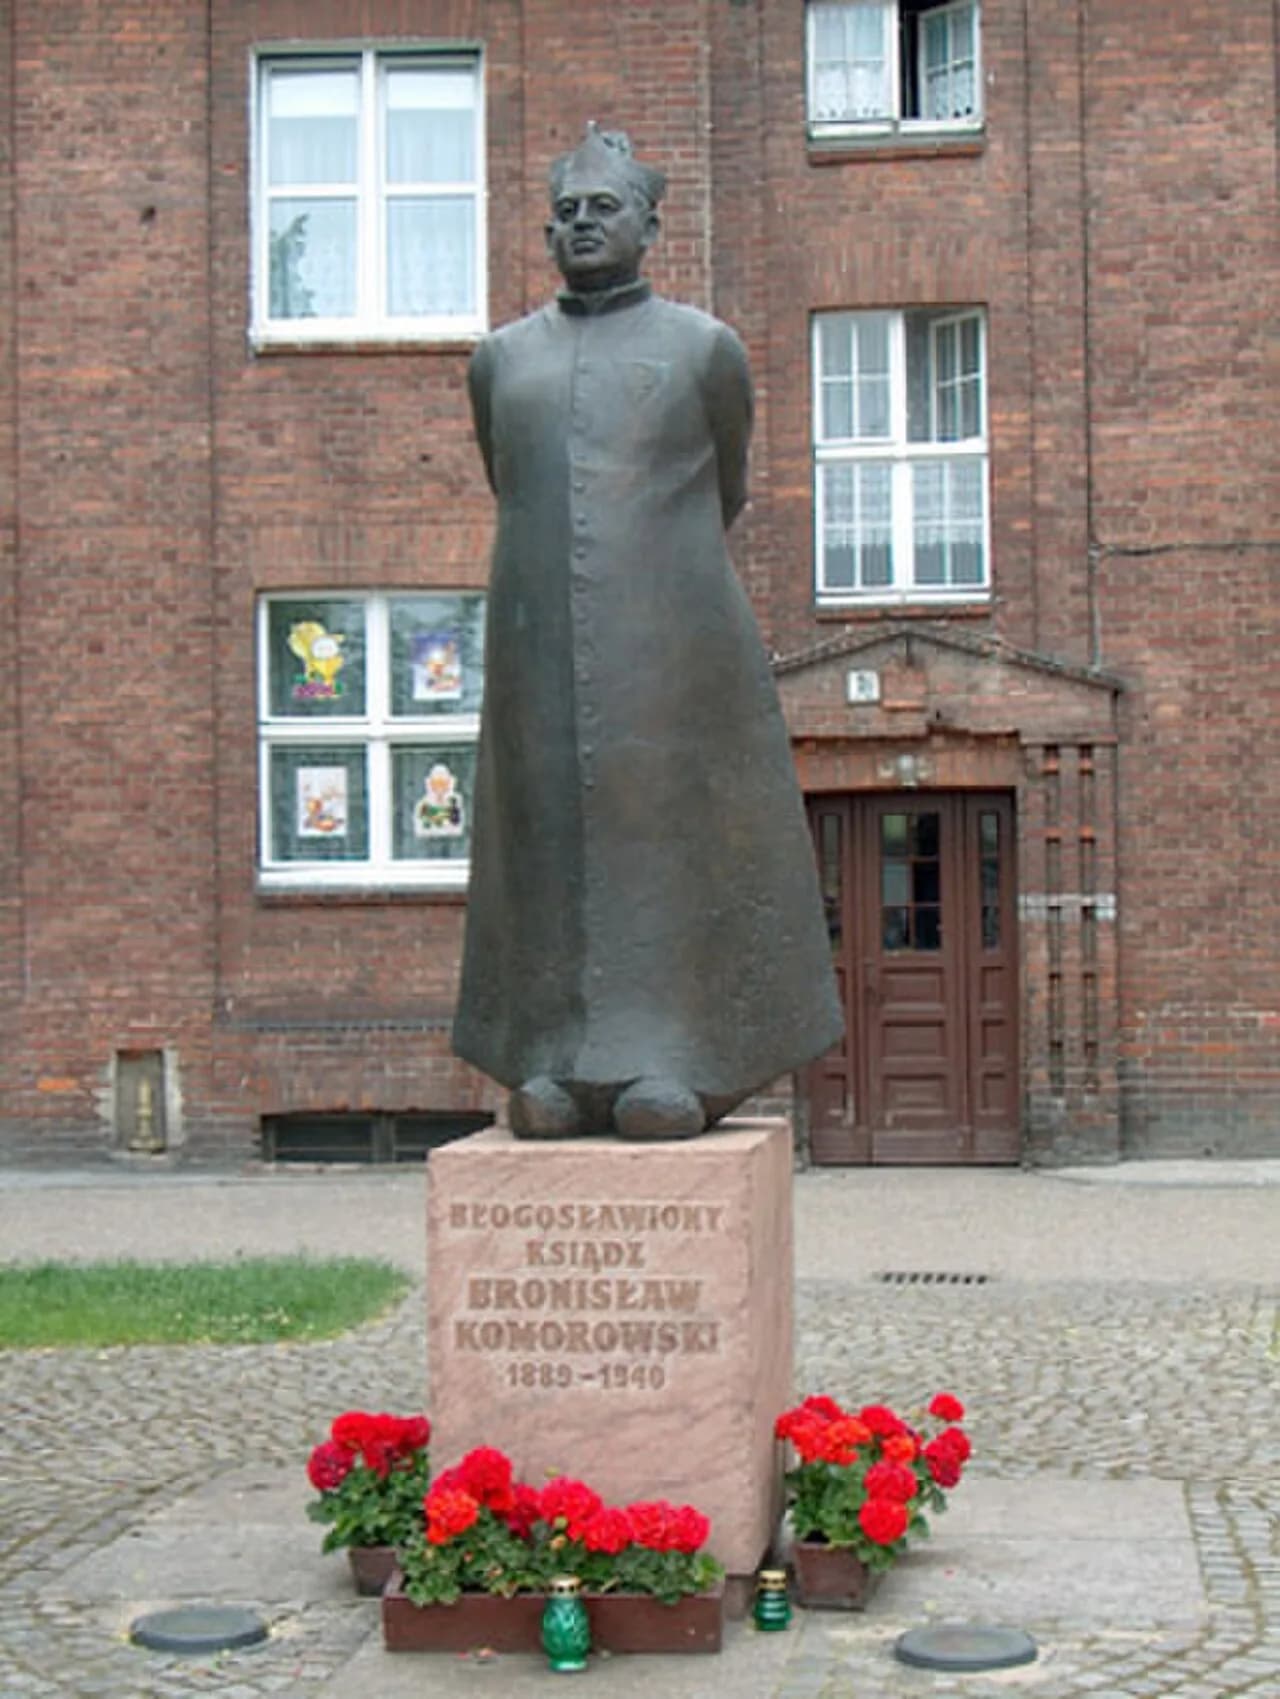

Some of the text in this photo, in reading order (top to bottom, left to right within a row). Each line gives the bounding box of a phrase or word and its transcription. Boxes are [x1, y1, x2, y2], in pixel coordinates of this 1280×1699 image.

[449, 1203, 724, 1232] BŁOGOSŁAWIONY
[525, 1240, 646, 1273] KSIĄDZ
[467, 1278, 703, 1312] BRONISŁAW
[453, 1321, 721, 1353] KOMOROWSKI
